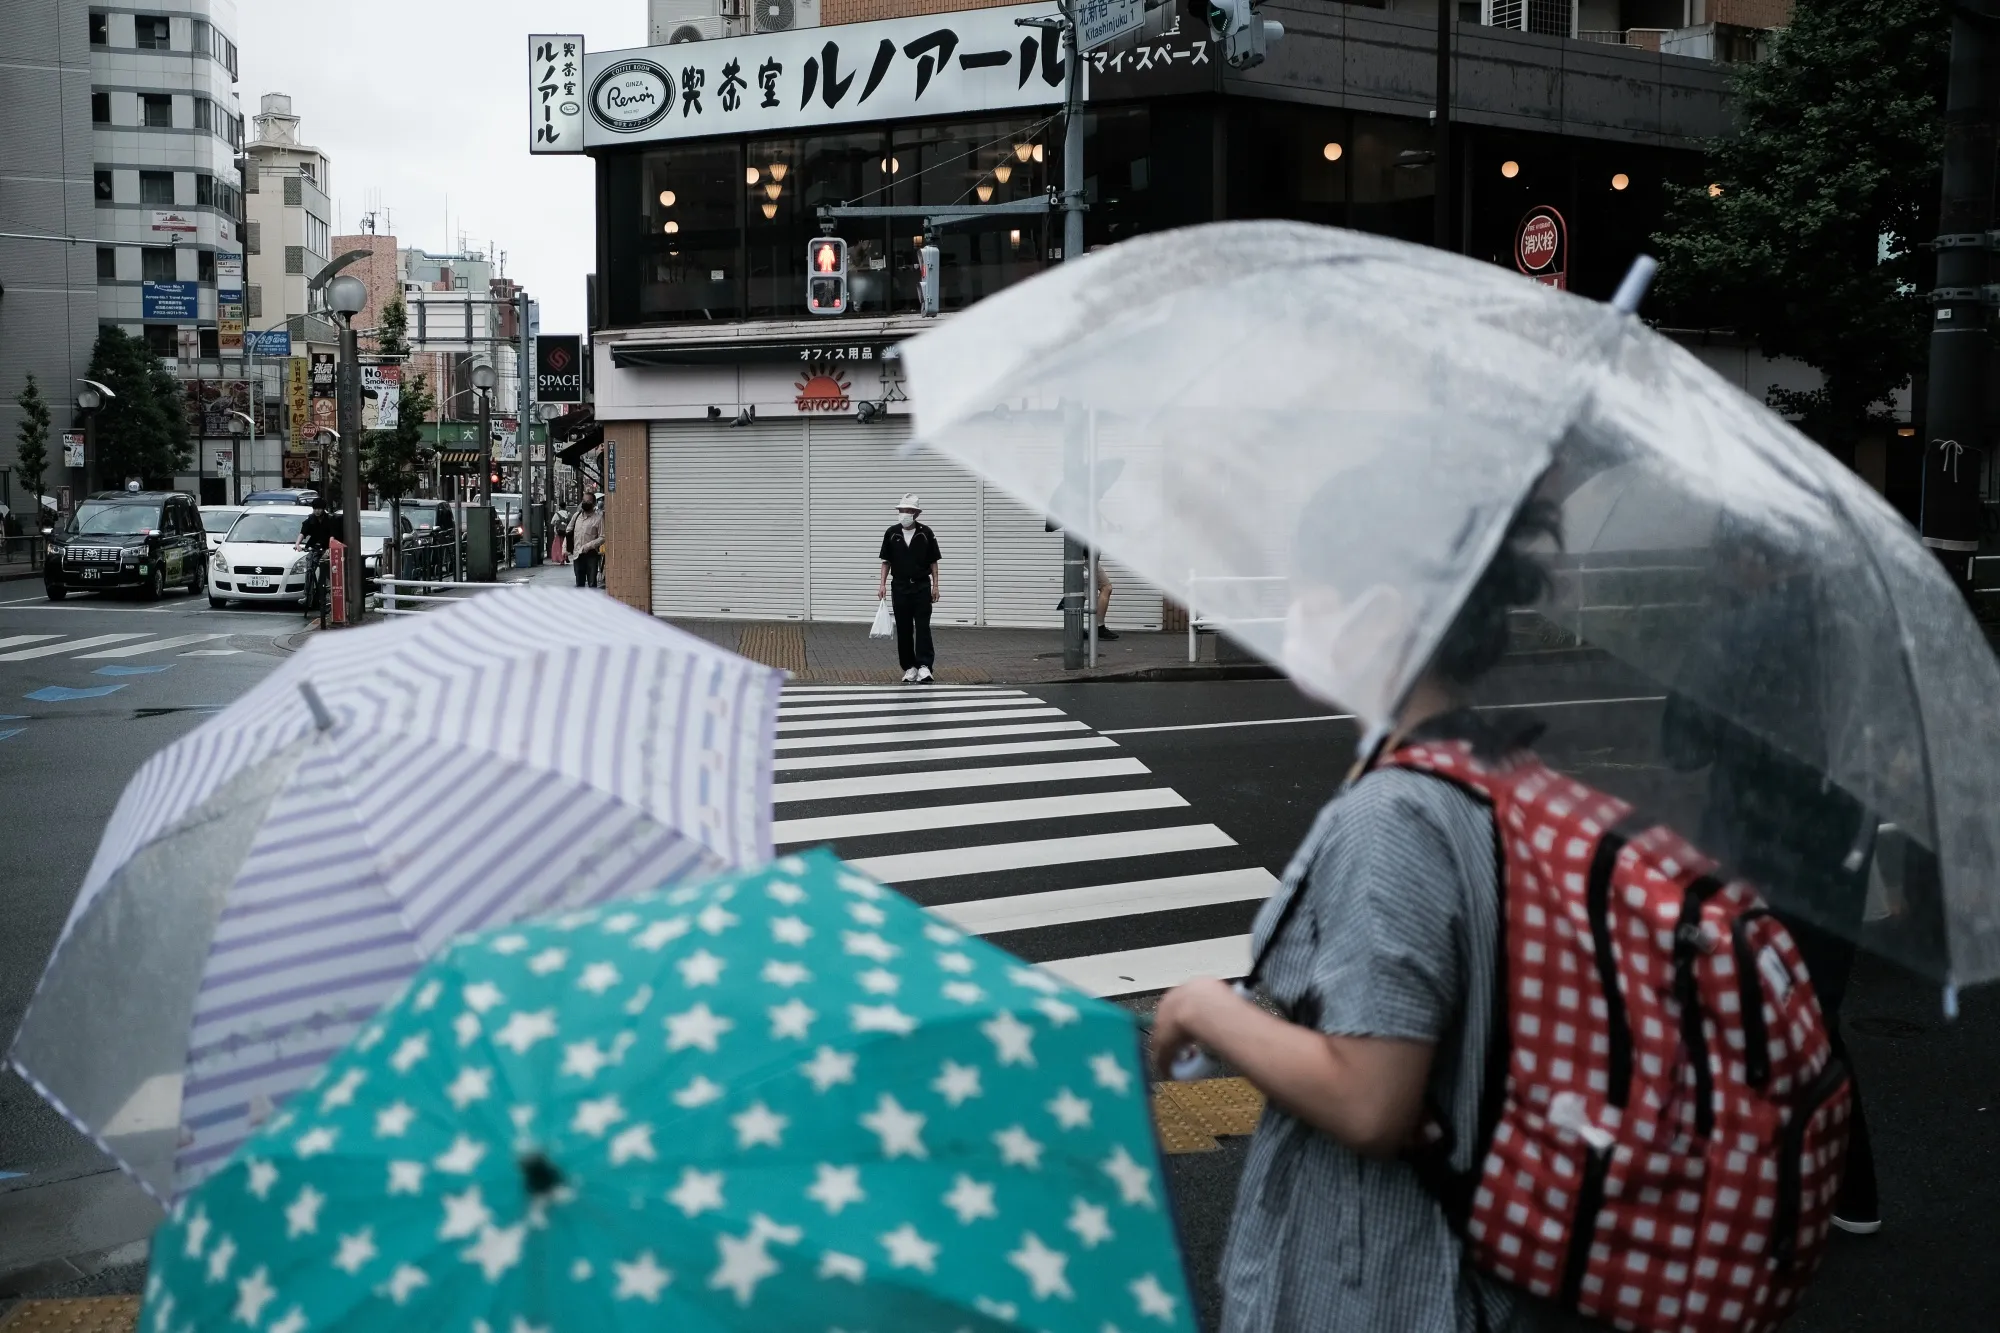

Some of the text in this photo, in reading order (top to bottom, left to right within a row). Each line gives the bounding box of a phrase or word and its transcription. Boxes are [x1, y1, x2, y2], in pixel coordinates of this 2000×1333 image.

[1086, 8, 1134, 41] Kitashinjuku 1
[1092, 41, 1209, 73] マイ・スペース
[562, 43, 577, 96] 喫茶室
[536, 42, 561, 143] ルノアール
[607, 86, 655, 109] Renoir
[1525, 230, 1554, 255] 消火栓
[800, 347, 873, 360] オフィス用品
[365, 368, 381, 377] No
[539, 375, 579, 386] SPACE
[795, 399, 850, 411] TAIYODO
